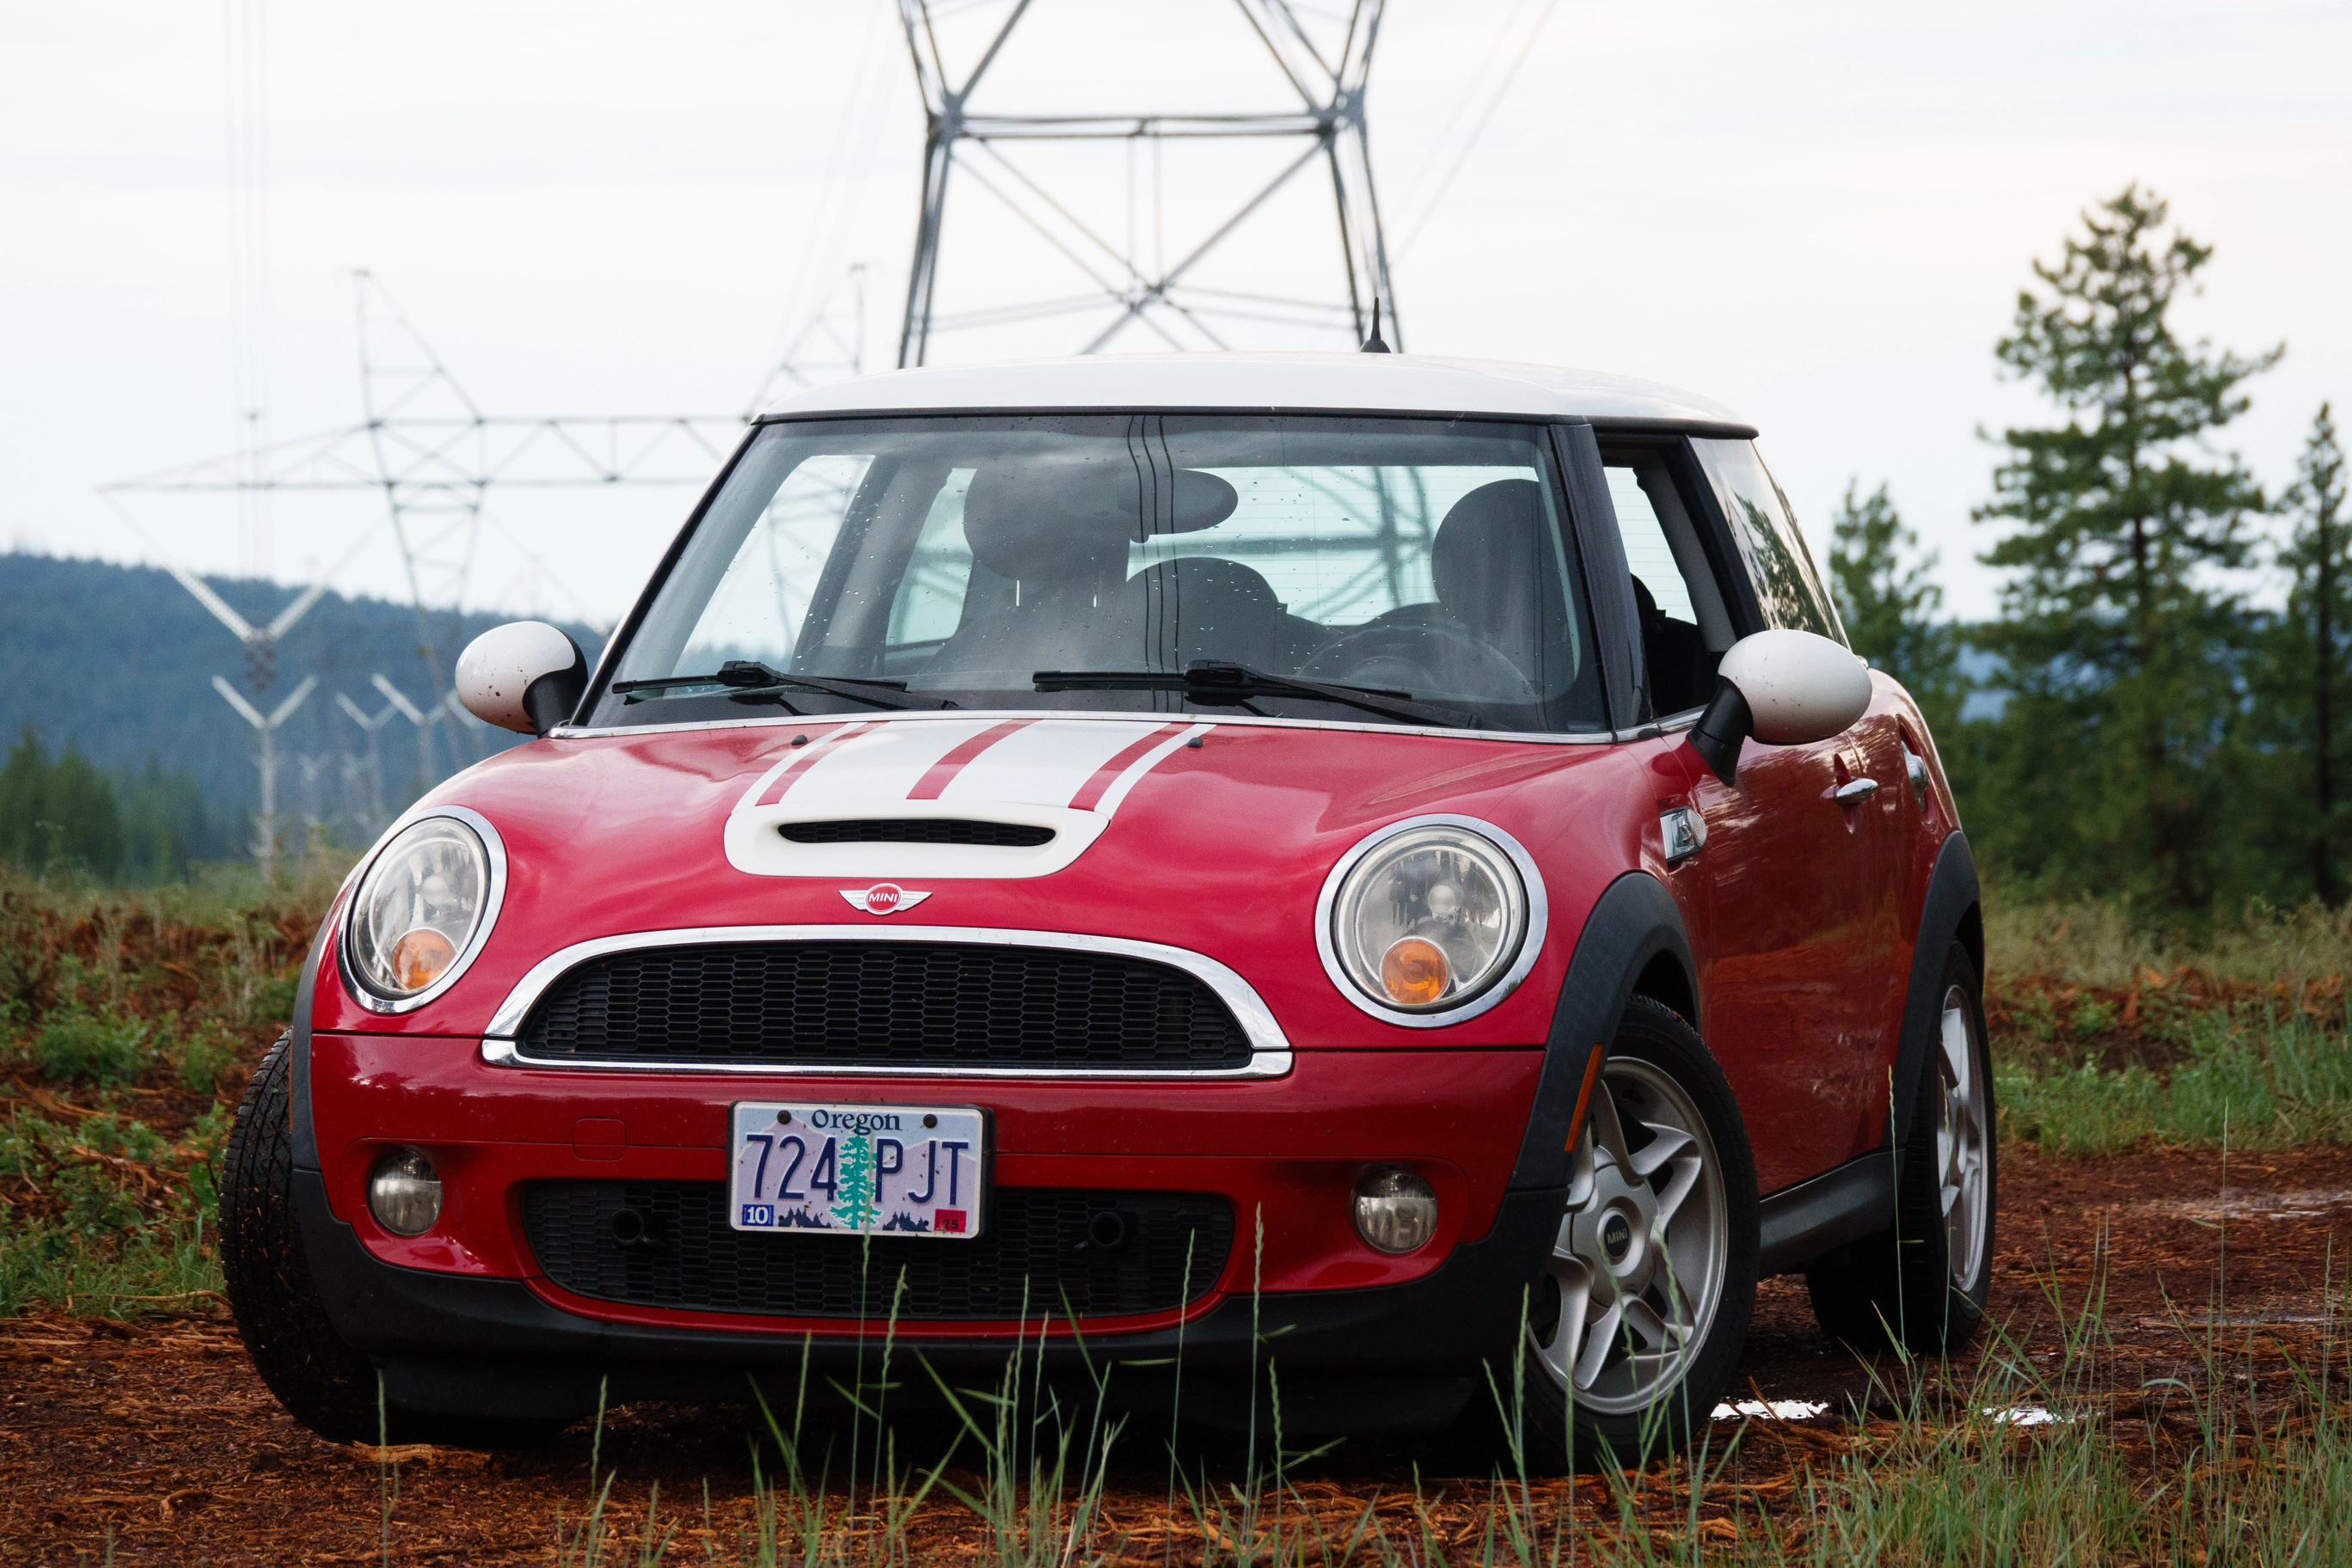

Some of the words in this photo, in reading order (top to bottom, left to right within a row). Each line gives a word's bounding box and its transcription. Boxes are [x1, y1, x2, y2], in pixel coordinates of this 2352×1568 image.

[868, 892, 898, 903] MINI
[812, 1109, 903, 1136] Oregon
[746, 1134, 837, 1201] 724
[874, 1138, 969, 1205] PJT
[747, 1206, 769, 1224] 10
[1607, 1228, 1627, 1245] MINI
